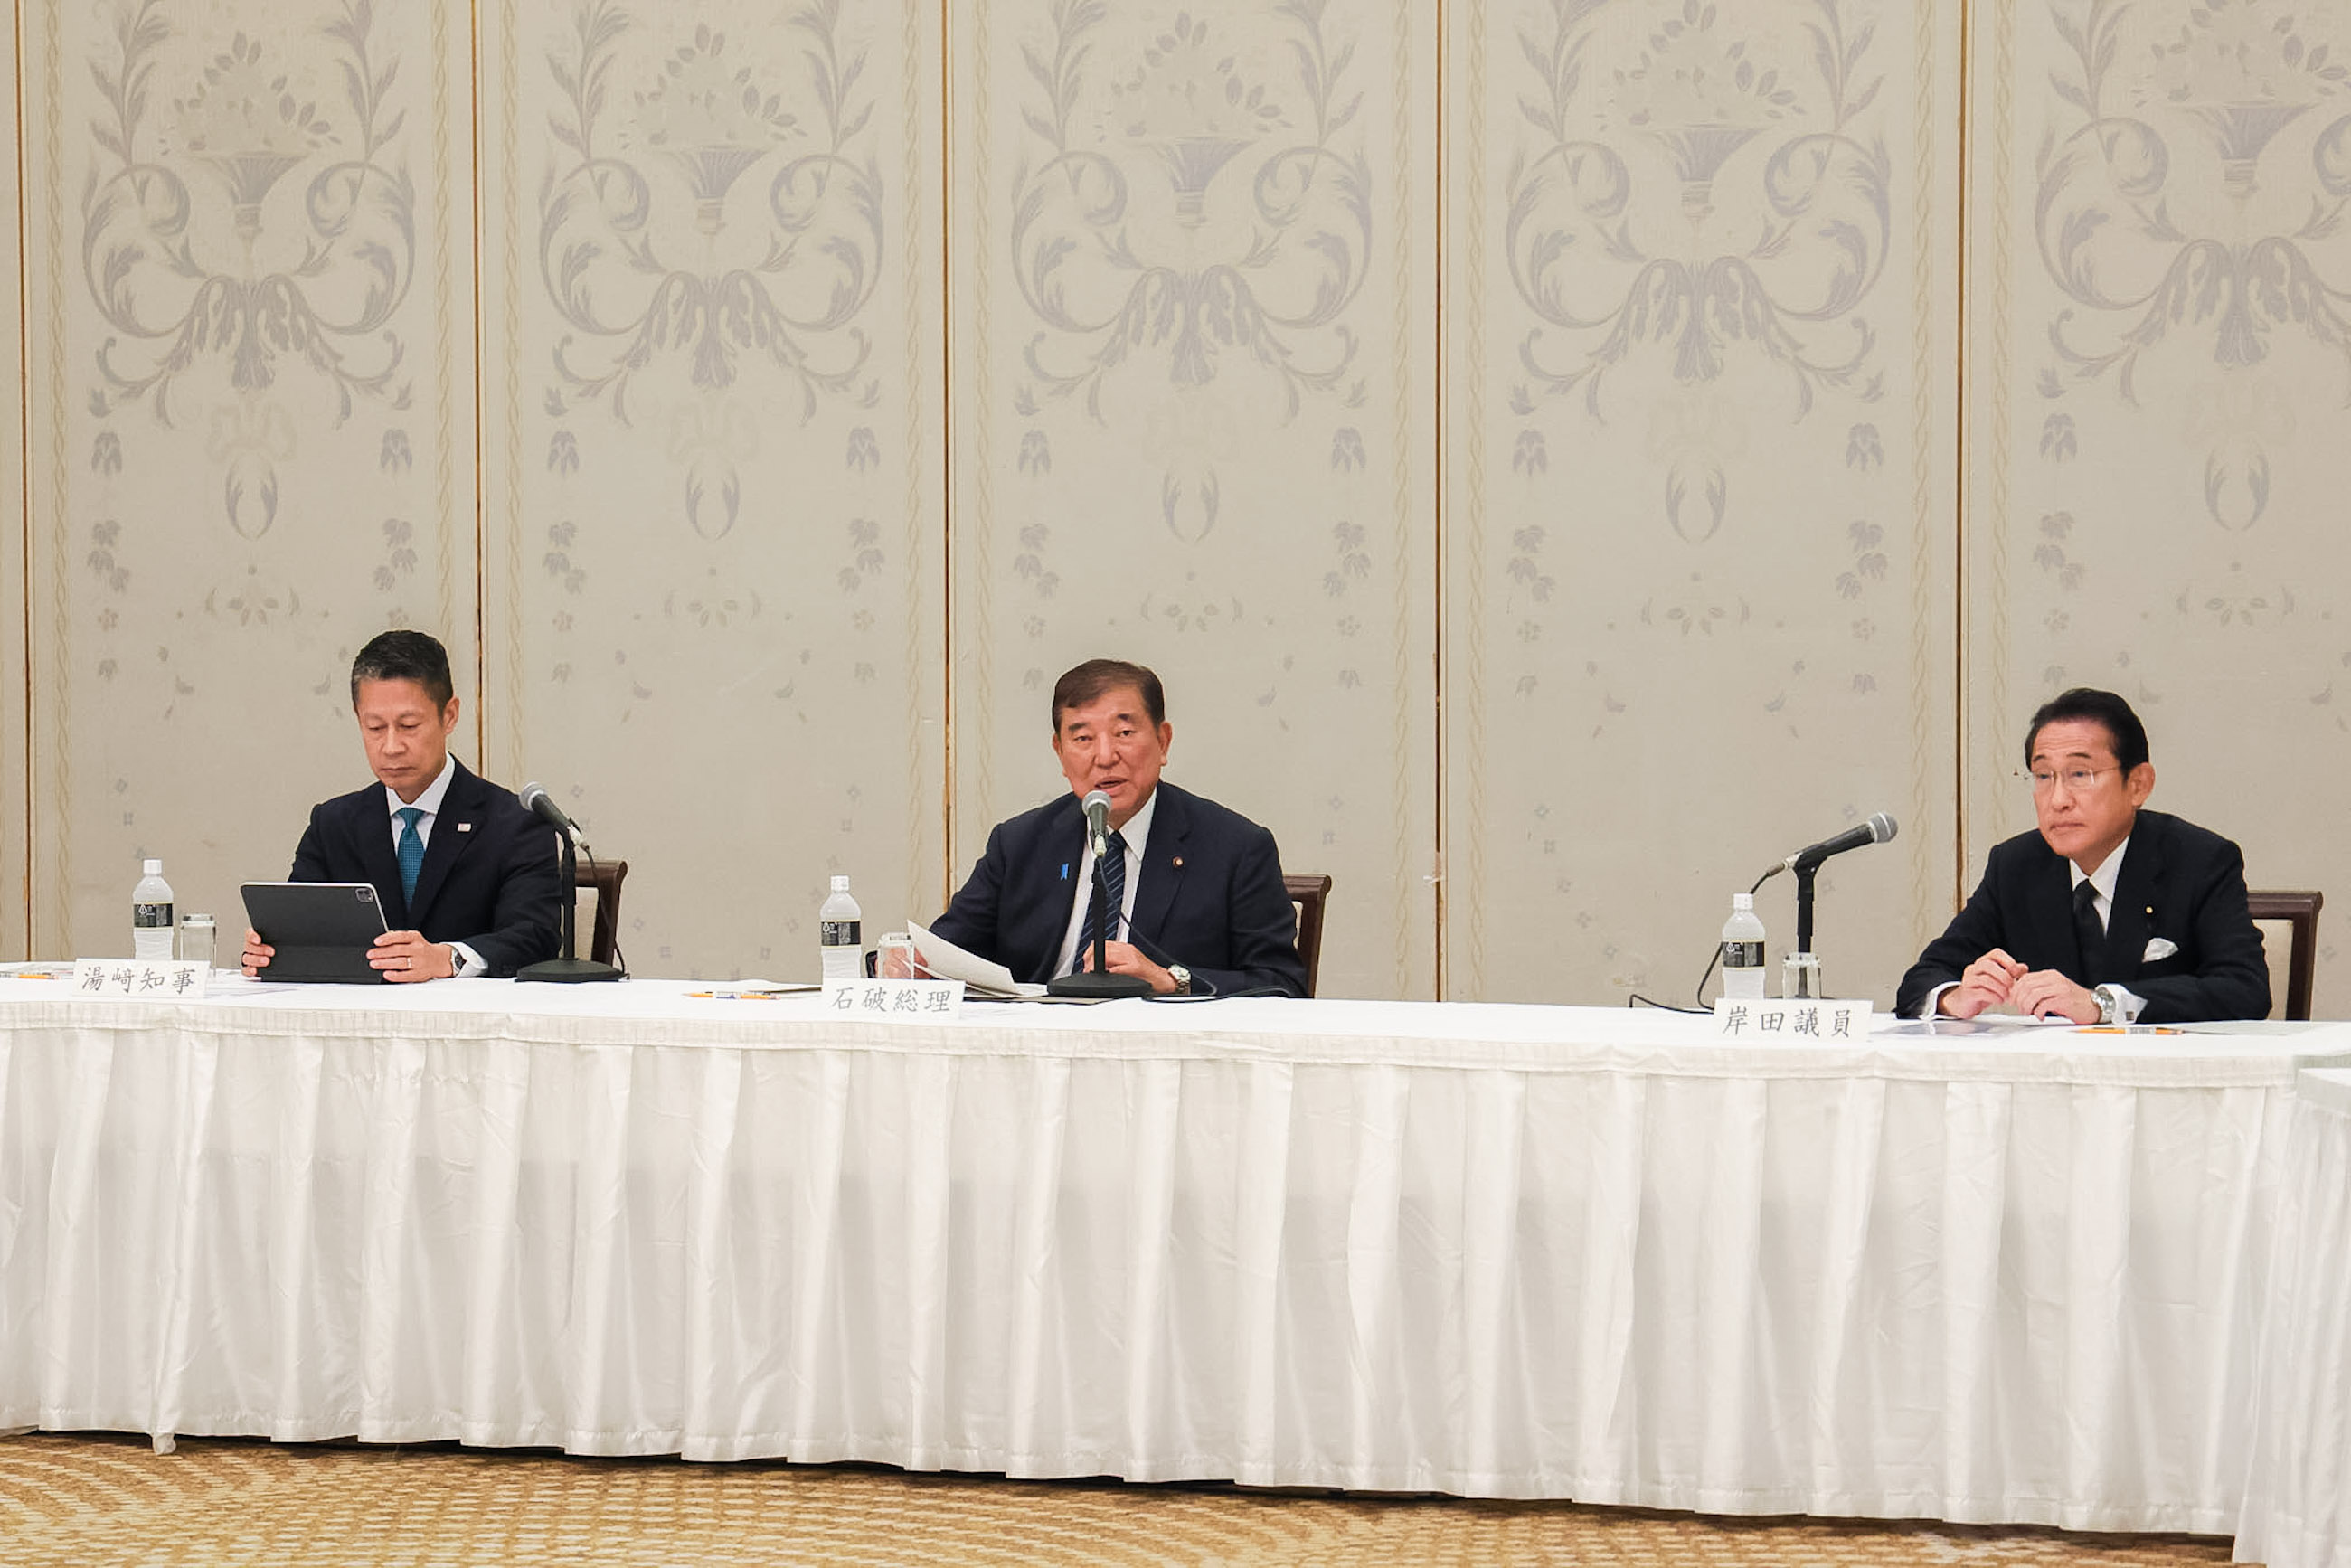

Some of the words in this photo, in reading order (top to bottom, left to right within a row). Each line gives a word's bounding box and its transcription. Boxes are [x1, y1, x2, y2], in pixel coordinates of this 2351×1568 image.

[832, 986, 950, 1012] 石破総理
[1723, 1006, 1850, 1037] 岸田議員
